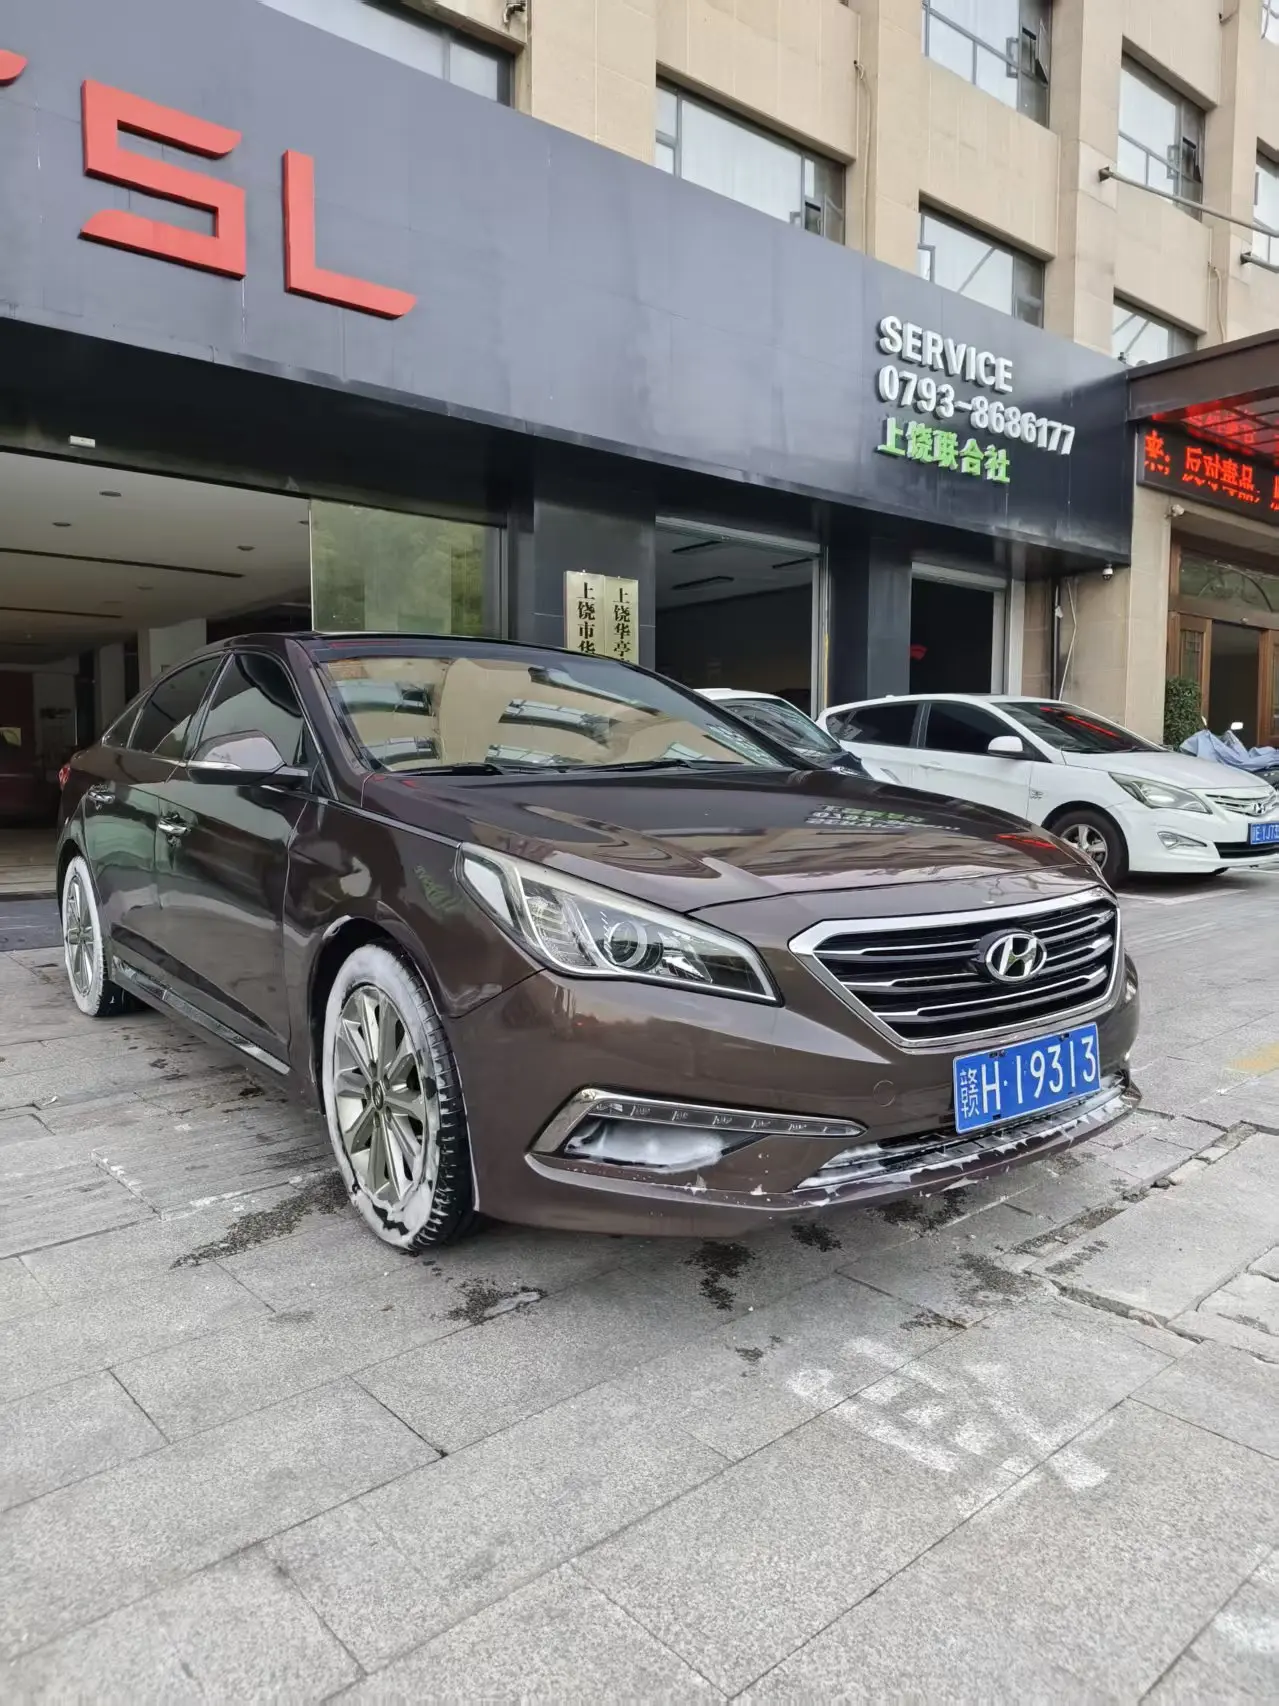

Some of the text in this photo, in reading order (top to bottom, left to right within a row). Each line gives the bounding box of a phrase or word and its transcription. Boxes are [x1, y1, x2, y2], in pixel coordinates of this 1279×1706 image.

[0, 50, 417, 320] SL
[879, 315, 1013, 393] SERVICE
[878, 364, 1075, 455] 0793-8686177
[612, 587, 631, 662] 上饶华亭
